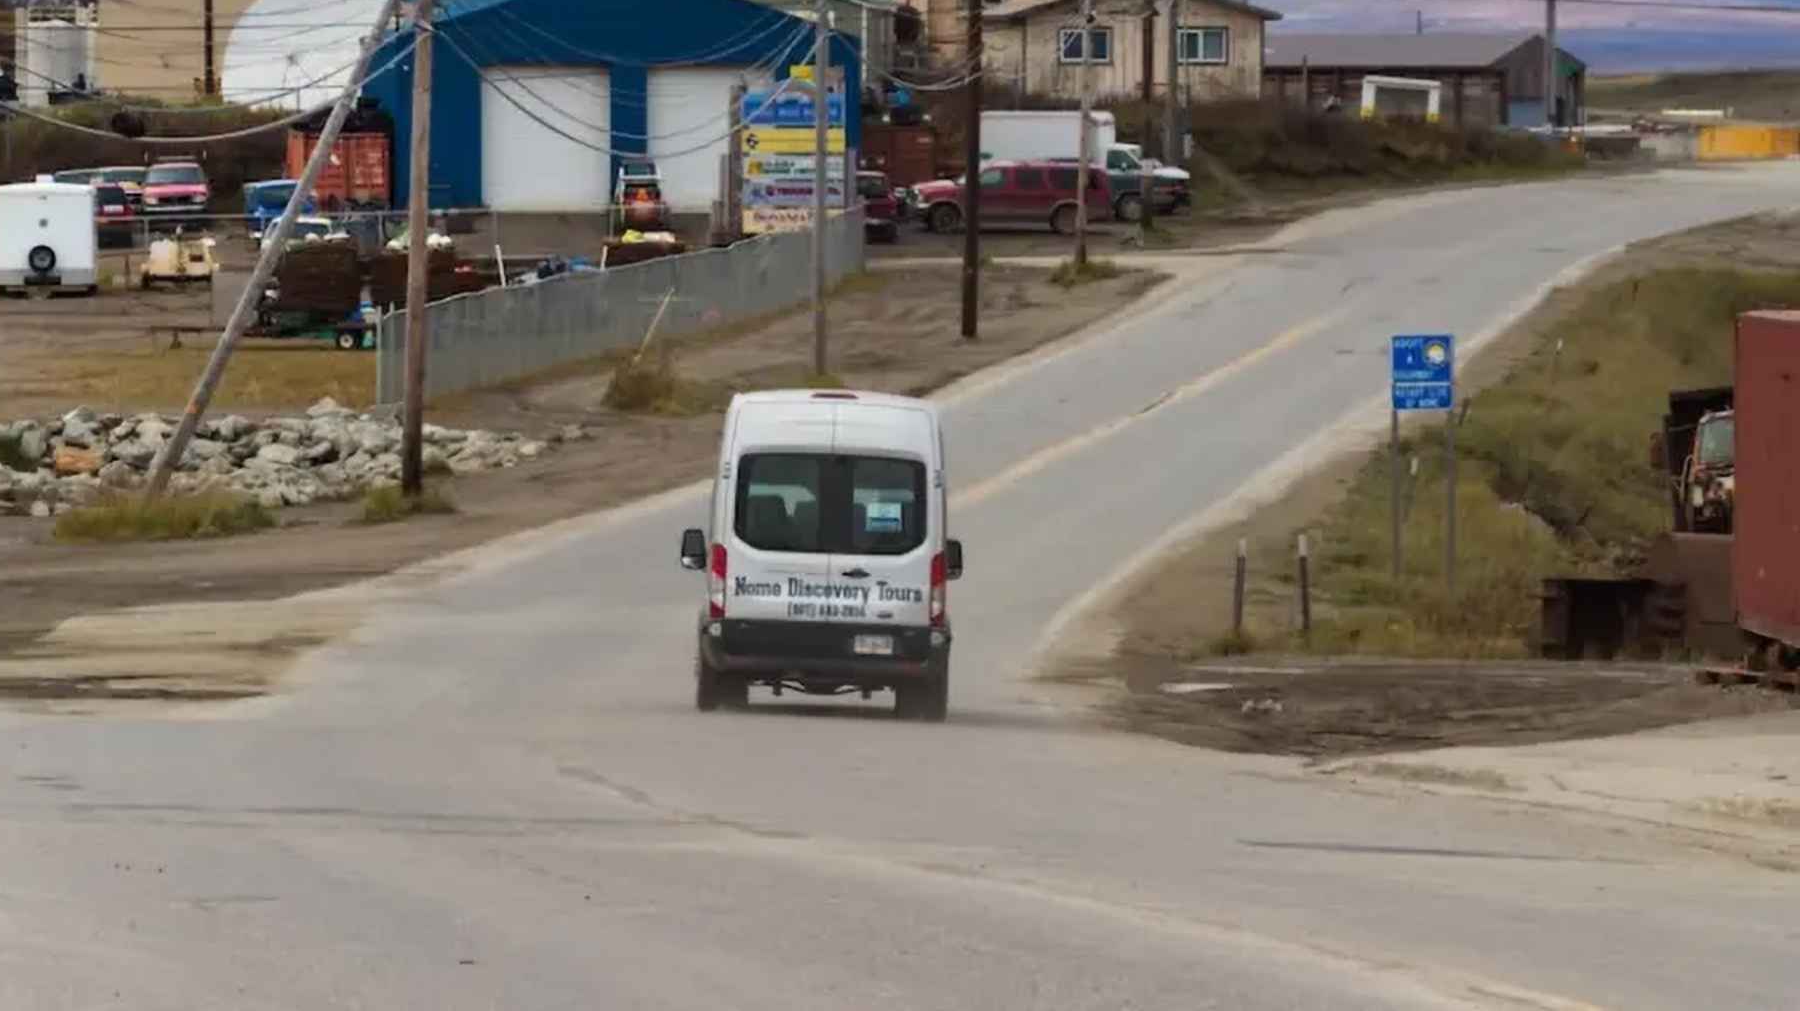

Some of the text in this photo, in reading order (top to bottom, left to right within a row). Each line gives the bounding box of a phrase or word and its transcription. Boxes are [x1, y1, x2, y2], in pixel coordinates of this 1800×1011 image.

[734, 576, 923, 605] Nome Discovery Tours
